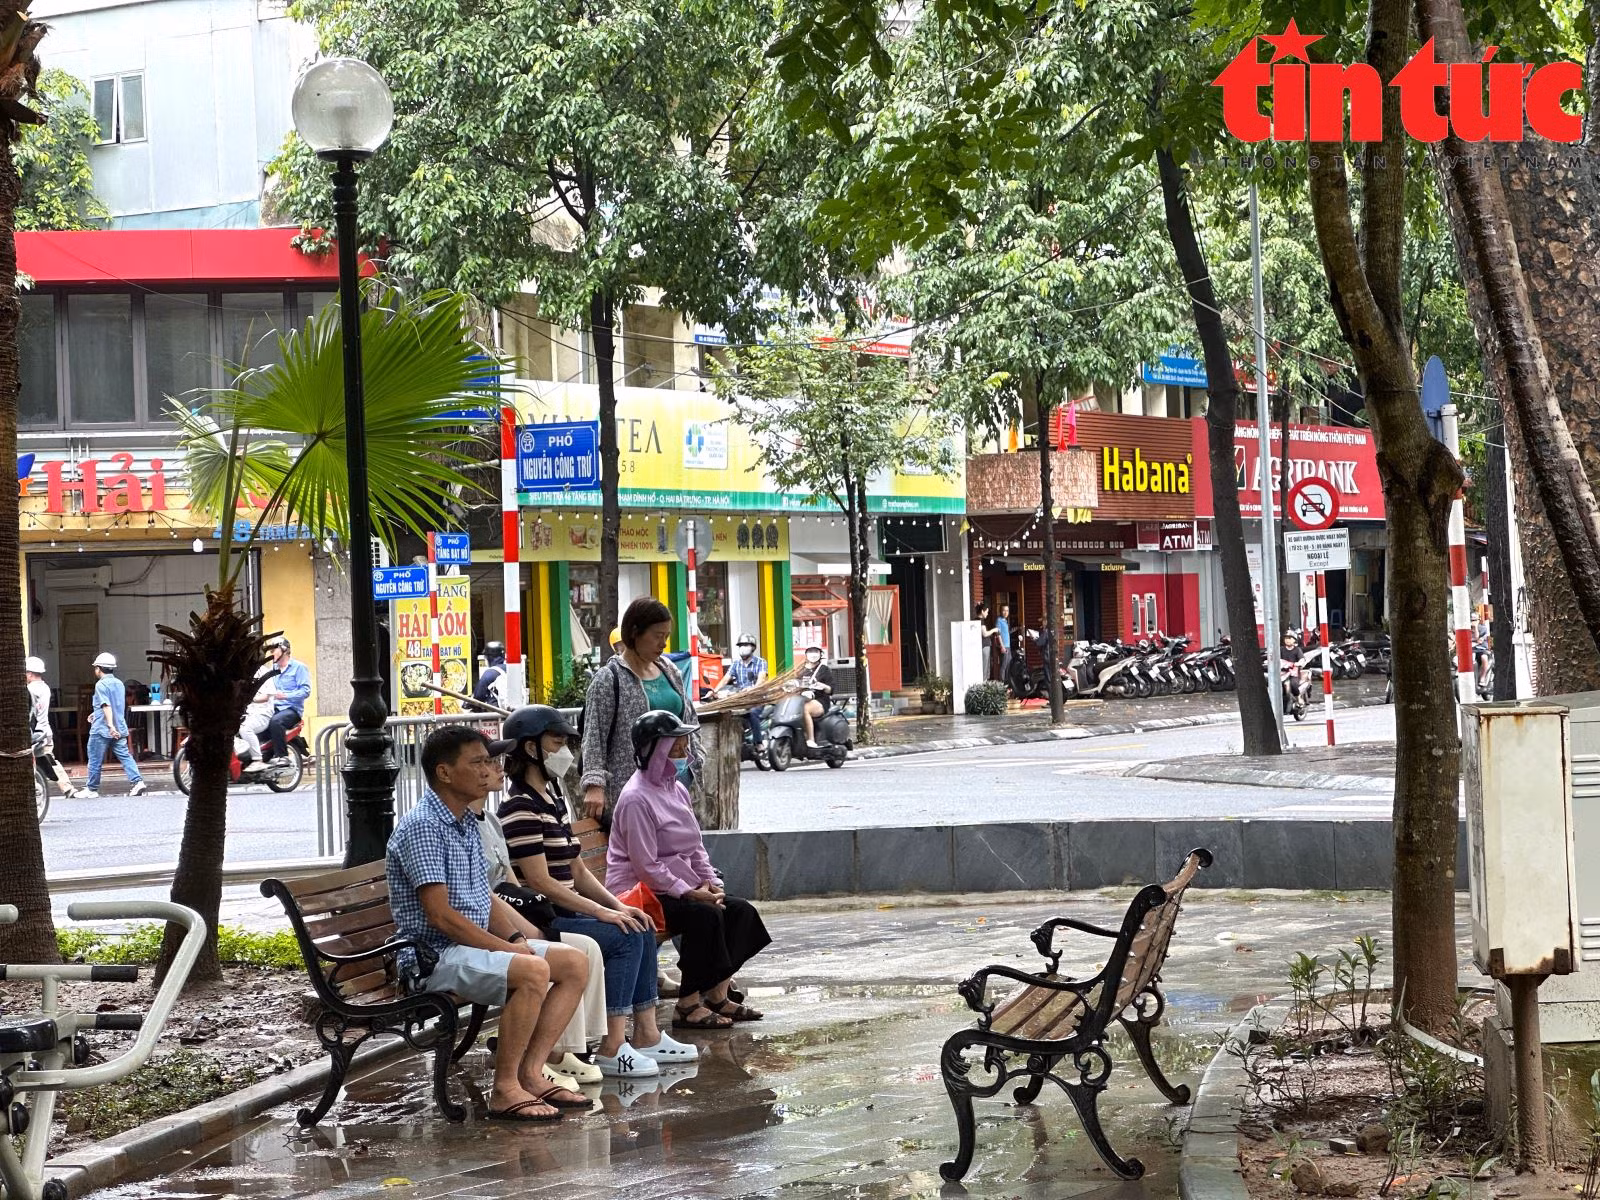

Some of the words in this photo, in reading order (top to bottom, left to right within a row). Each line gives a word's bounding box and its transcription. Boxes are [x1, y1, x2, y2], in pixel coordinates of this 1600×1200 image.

[548, 430, 574, 447] PHỐ
[523, 450, 552, 480] NGUYỄN
[554, 452, 575, 479] CÔNG
[577, 451, 592, 478] TRỨ
[1103, 446, 1190, 493] Habana
[41, 452, 169, 514] Hải
[447, 537, 459, 545] PHỐ
[1163, 535, 1192, 549] ATM
[393, 569, 411, 578] PHỐ
[1101, 563, 1126, 571] Exclusive
[398, 579, 412, 593] CÔNG
[399, 603, 429, 637] HẢI
[408, 641, 421, 657] 48
[618, 1054, 634, 1073] NY
